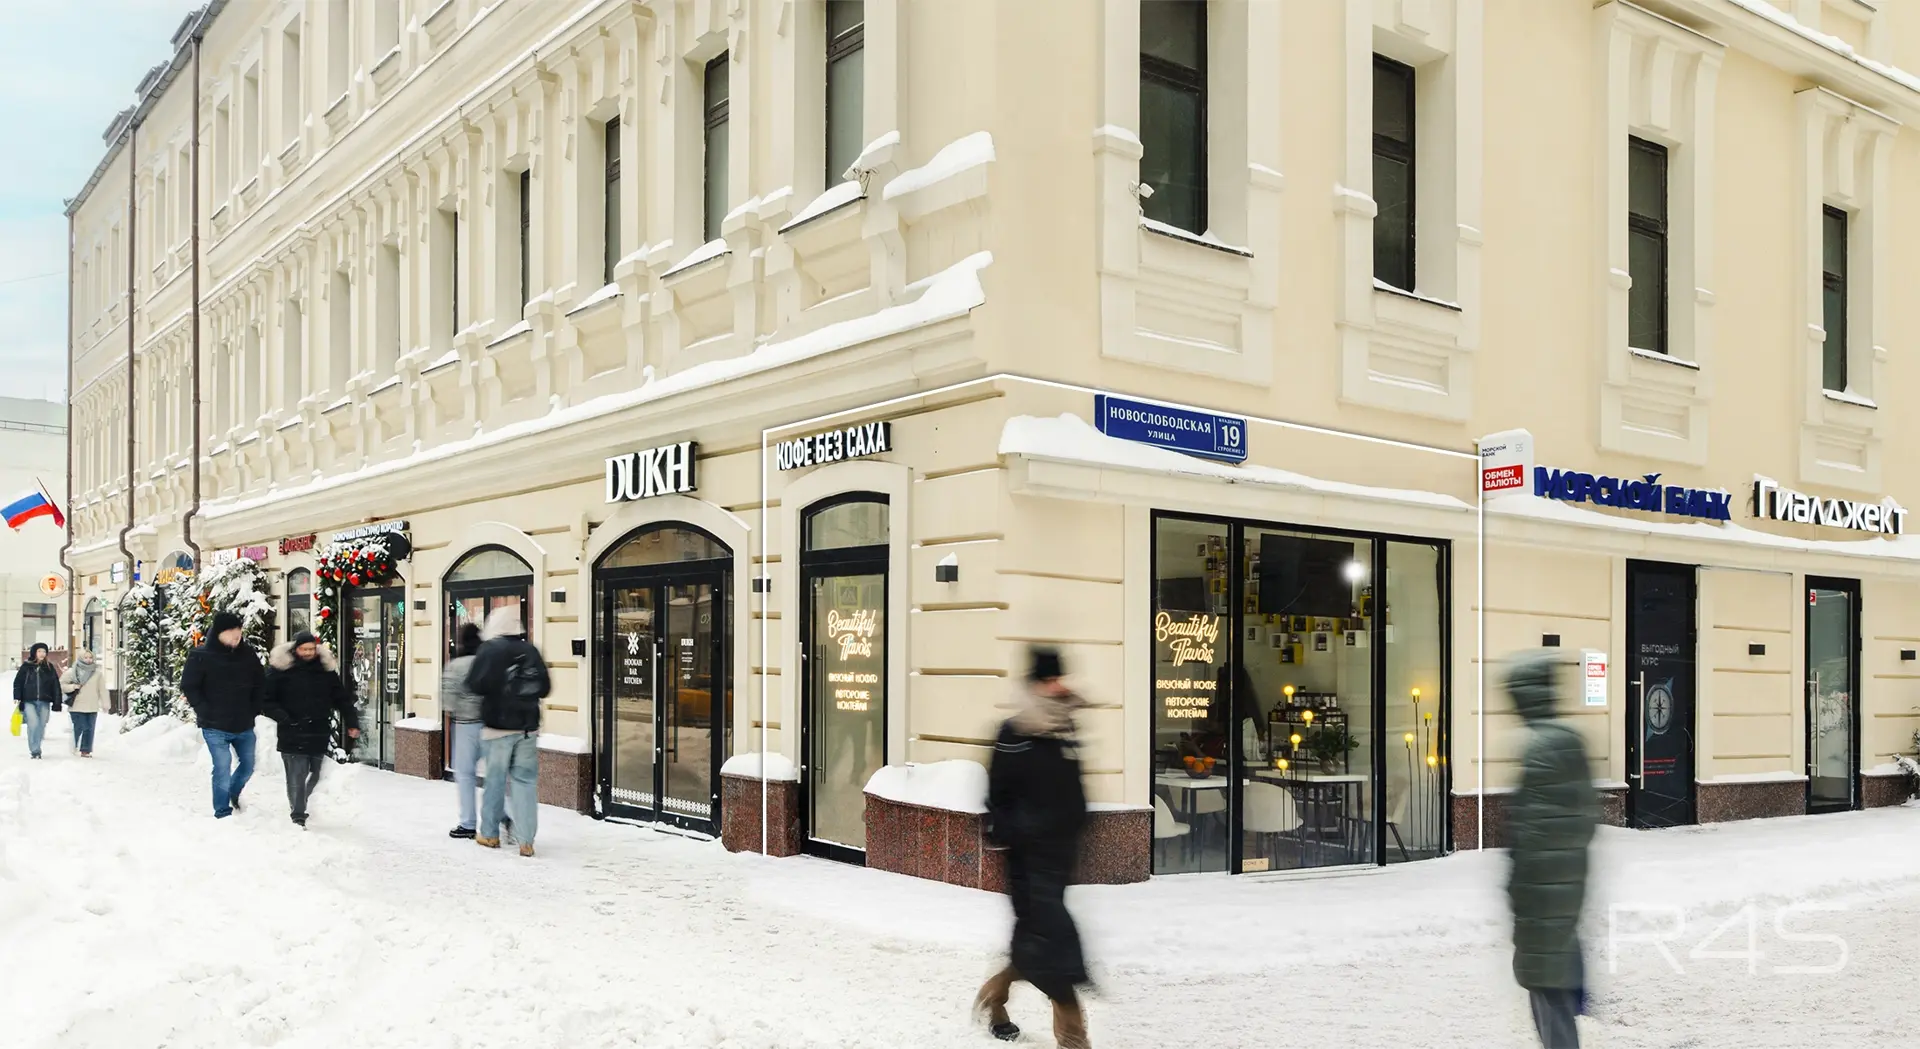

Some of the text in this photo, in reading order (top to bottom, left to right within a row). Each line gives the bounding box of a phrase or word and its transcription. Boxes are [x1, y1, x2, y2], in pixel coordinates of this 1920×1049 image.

[1110, 406, 1211, 433] НОВОСЛОБОДСКАЯ
[776, 421, 886, 470] КОФЕ БЕЗ САХА
[1147, 429, 1176, 441] УЛИЦА
[1221, 425, 1240, 448] 19
[604, 441, 692, 504] DUKH
[1484, 469, 1514, 480] ОБМЕН
[1485, 477, 1521, 488] ВАЛЮТЫ
[1533, 467, 1732, 520] МОРСКОЙ БАНК
[828, 609, 876, 638] Beautiful
[1155, 611, 1219, 643] Beautiful
[838, 633, 872, 661] Flavors
[1170, 637, 1214, 667] Flavors
[1641, 643, 1679, 655] ВЫГОДНЫЙ
[1641, 657, 1660, 666] КУРС
[1156, 679, 1217, 690] ВКУСНЫЙ КОФЕ
[1165, 696, 1210, 707] АВТОРСКИЕ
[1167, 708, 1208, 718] КОКТЕЙЛИ
